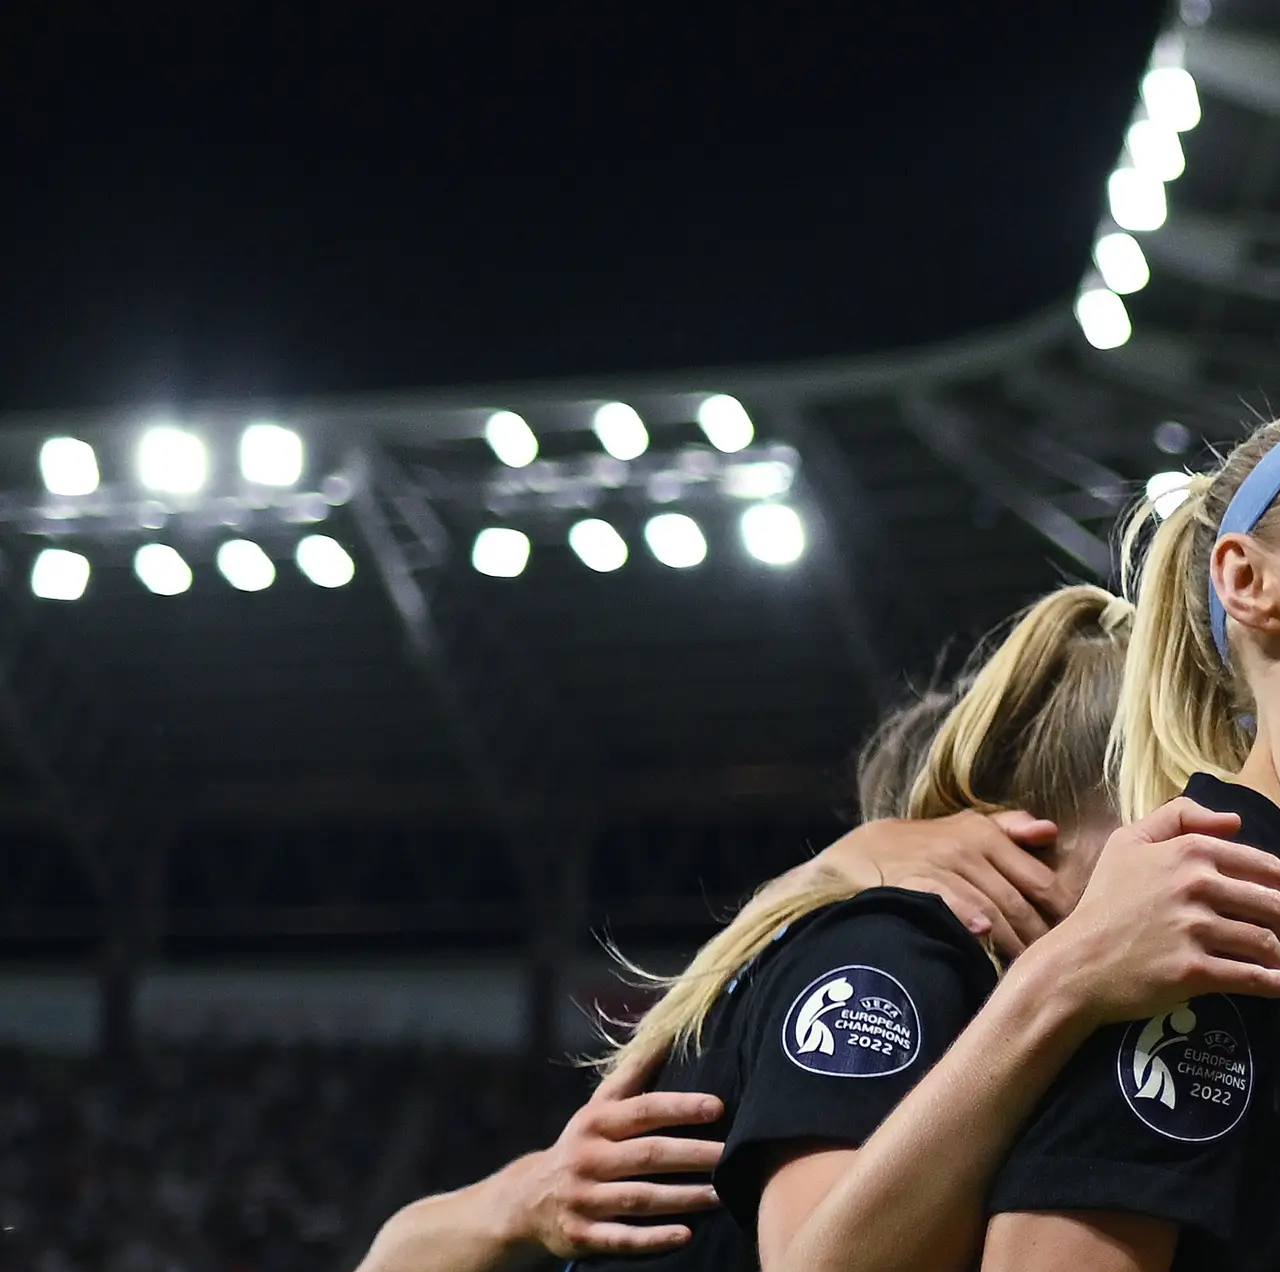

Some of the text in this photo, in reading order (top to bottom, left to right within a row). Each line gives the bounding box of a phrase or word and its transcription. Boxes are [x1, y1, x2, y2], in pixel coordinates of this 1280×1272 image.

[861, 1000, 898, 1018] UEFA
[835, 1019, 911, 1050] CHAMPIONS
[841, 1009, 910, 1038] EUROPEAN
[847, 1033, 893, 1056] 2022
[1204, 1034, 1235, 1052] UEFA
[1184, 1048, 1245, 1075] EUROPEAN
[1177, 1062, 1246, 1090] CHAMPIONS
[1190, 1083, 1231, 1106] 2022
